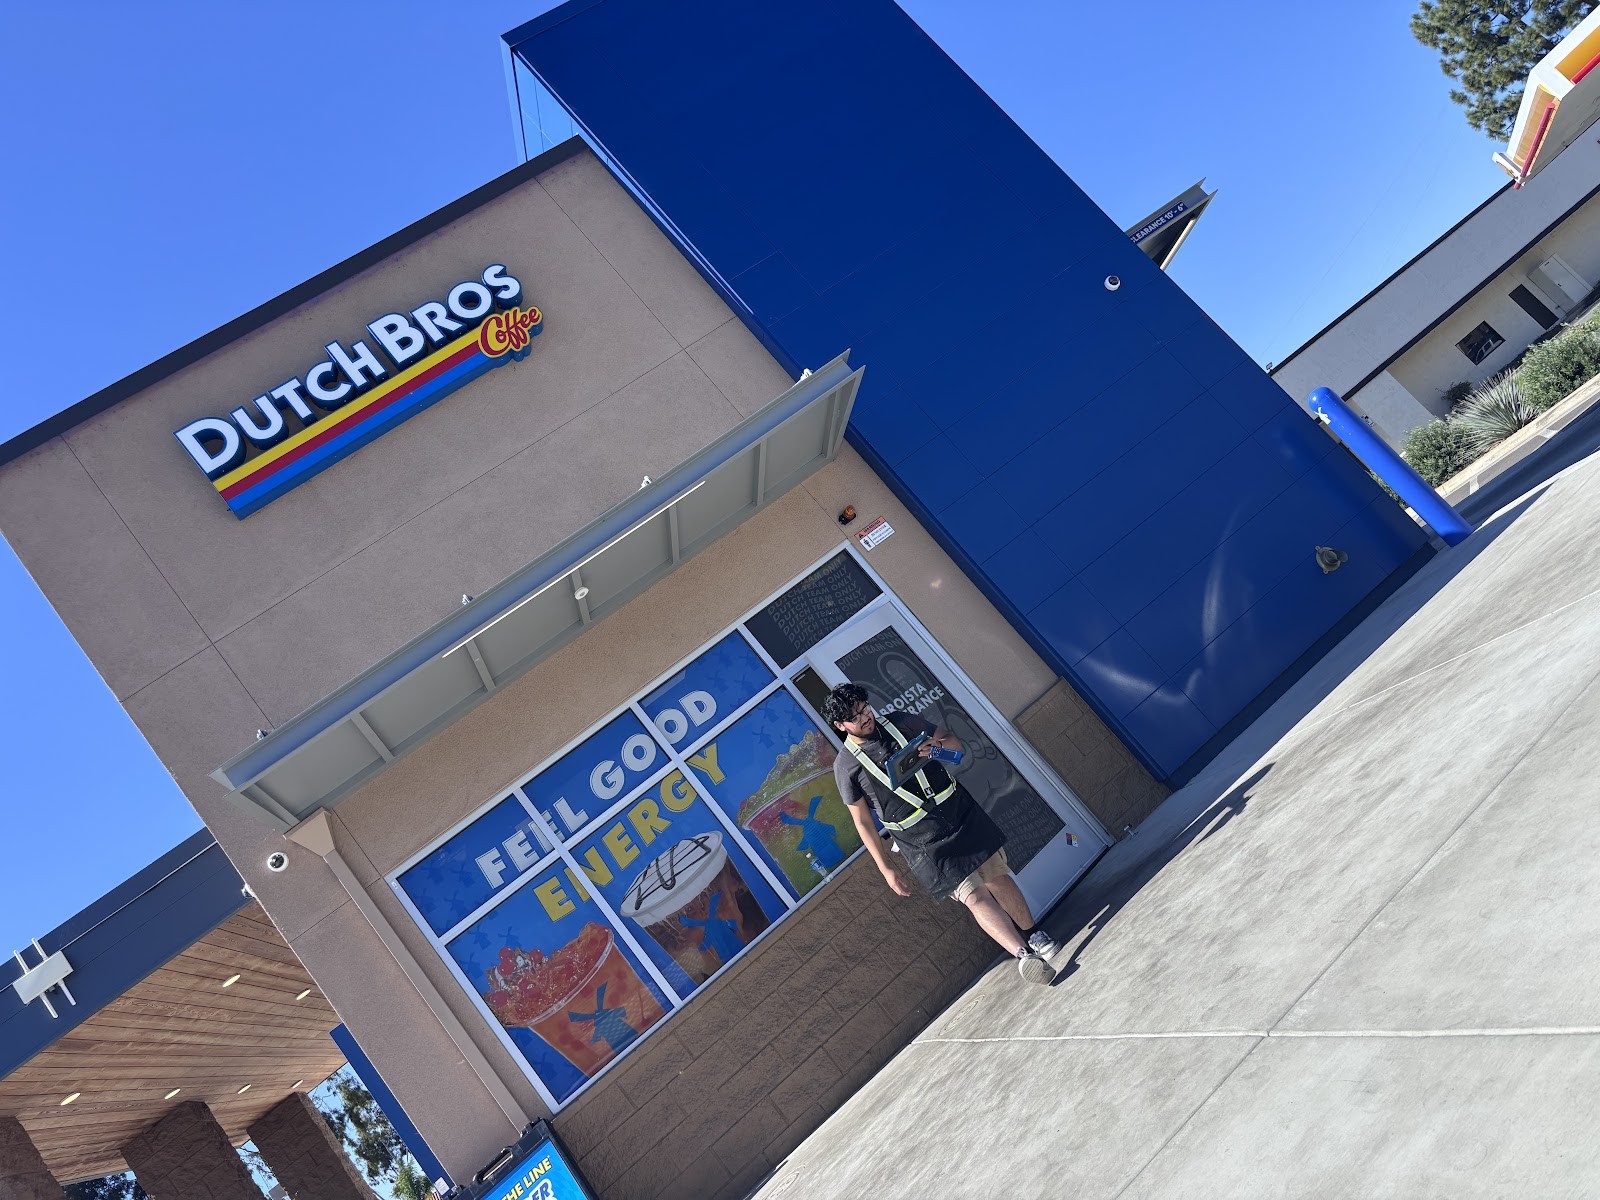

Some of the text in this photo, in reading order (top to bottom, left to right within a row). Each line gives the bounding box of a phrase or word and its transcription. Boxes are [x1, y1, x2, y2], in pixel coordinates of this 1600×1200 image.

[173, 263, 523, 475] DUTCH BROS
[480, 308, 542, 357] Coffee
[475, 690, 718, 890] FEEL GOOD
[533, 743, 727, 922] ENERGY
